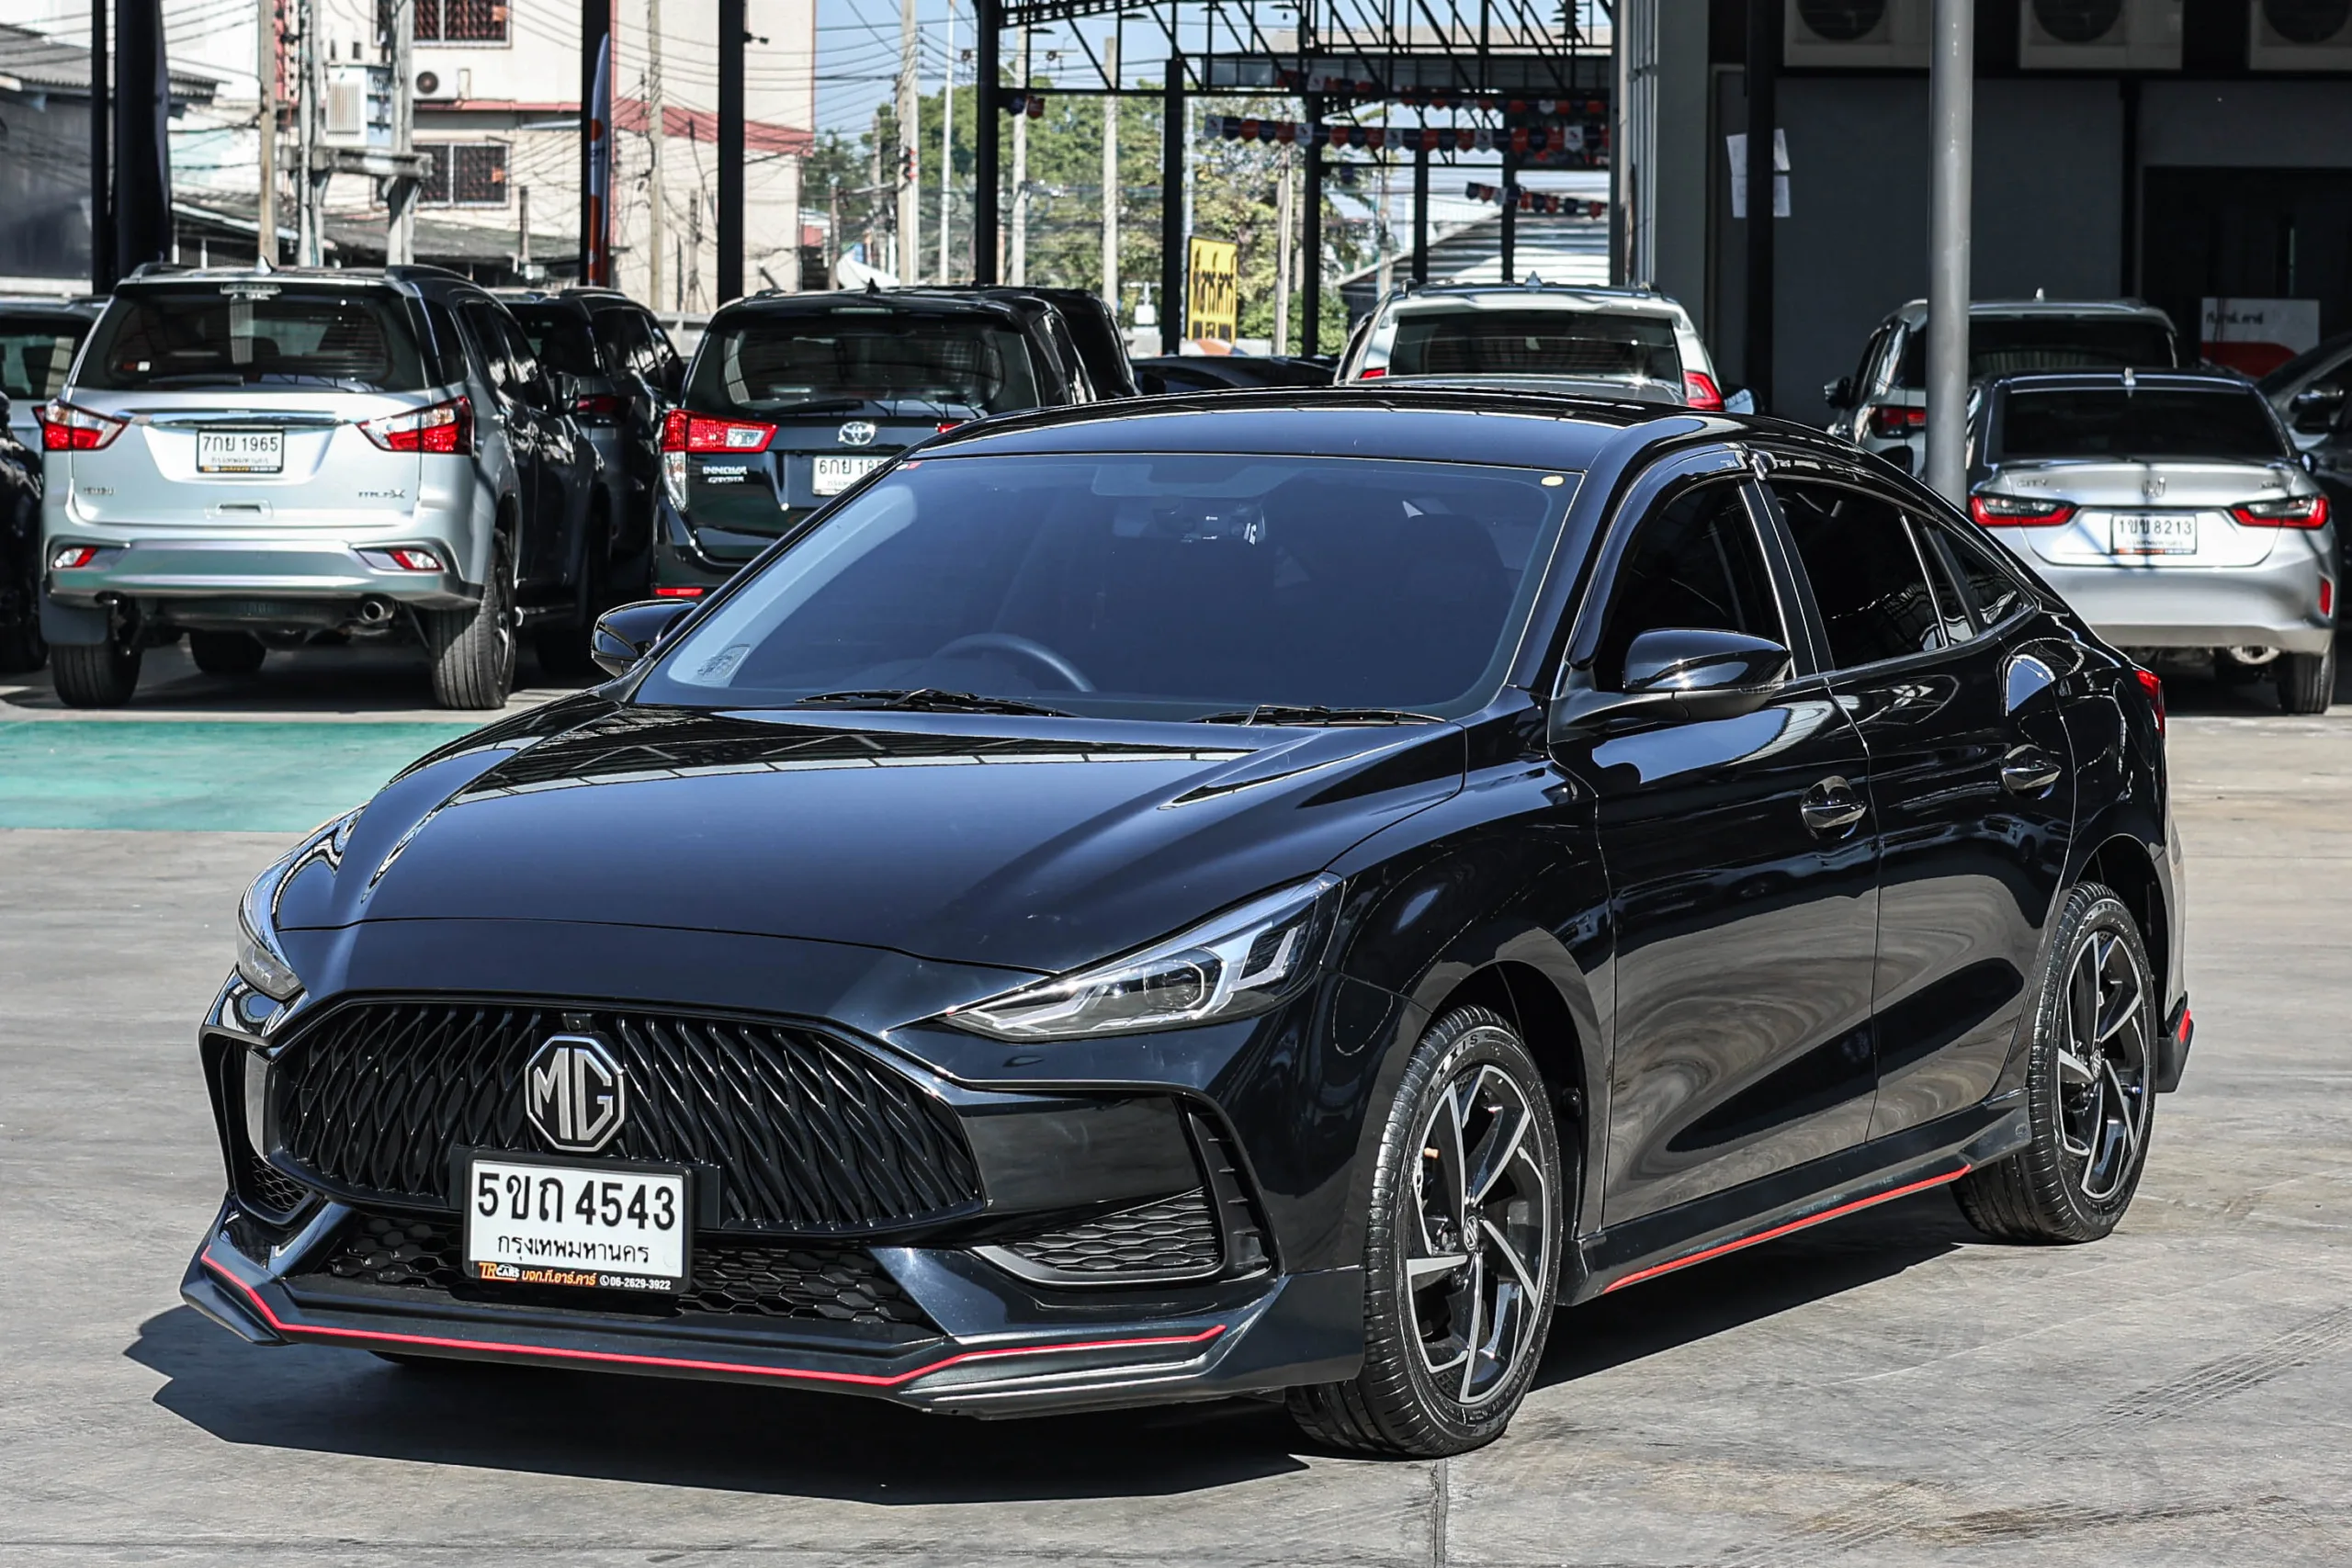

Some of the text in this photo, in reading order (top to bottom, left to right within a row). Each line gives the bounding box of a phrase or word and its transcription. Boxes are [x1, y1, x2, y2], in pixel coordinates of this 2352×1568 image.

[203, 436, 277, 451] 7กย 1965
[820, 459, 852, 474] 6กย
[2154, 520, 2191, 535] 8213
[534, 1047, 613, 1141] MG
[478, 1172, 675, 1231] 5ขถ 4543
[498, 1235, 650, 1264] กรุงเทพมหานคร
[609, 1276, 672, 1291] 06-2629-3922
